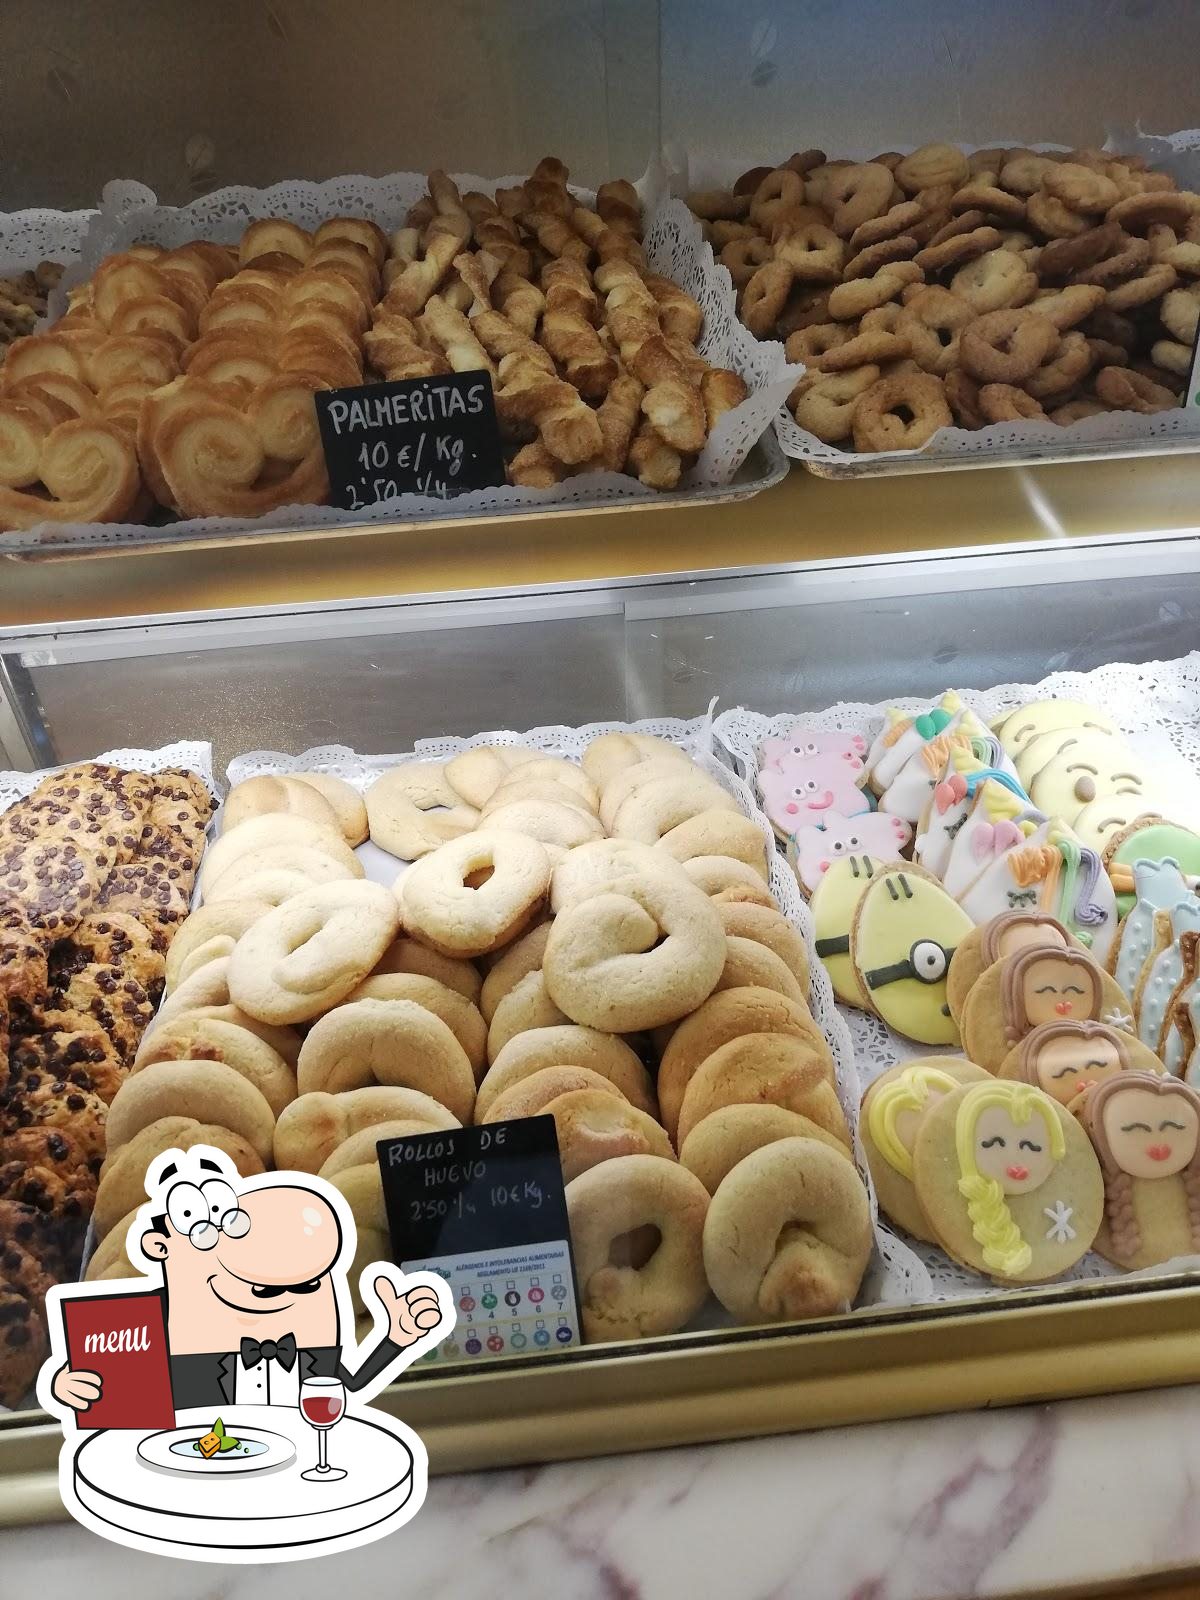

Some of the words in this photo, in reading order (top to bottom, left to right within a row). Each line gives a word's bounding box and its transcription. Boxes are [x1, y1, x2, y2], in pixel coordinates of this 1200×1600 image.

[388, 1139, 455, 1167] ROLLOS
[480, 1127, 508, 1150] DE
[424, 1160, 487, 1187] HUEVO
[488, 1311, 495, 1319] 4
[511, 1308, 518, 1316] 5
[557, 1302, 564, 1310] 7
